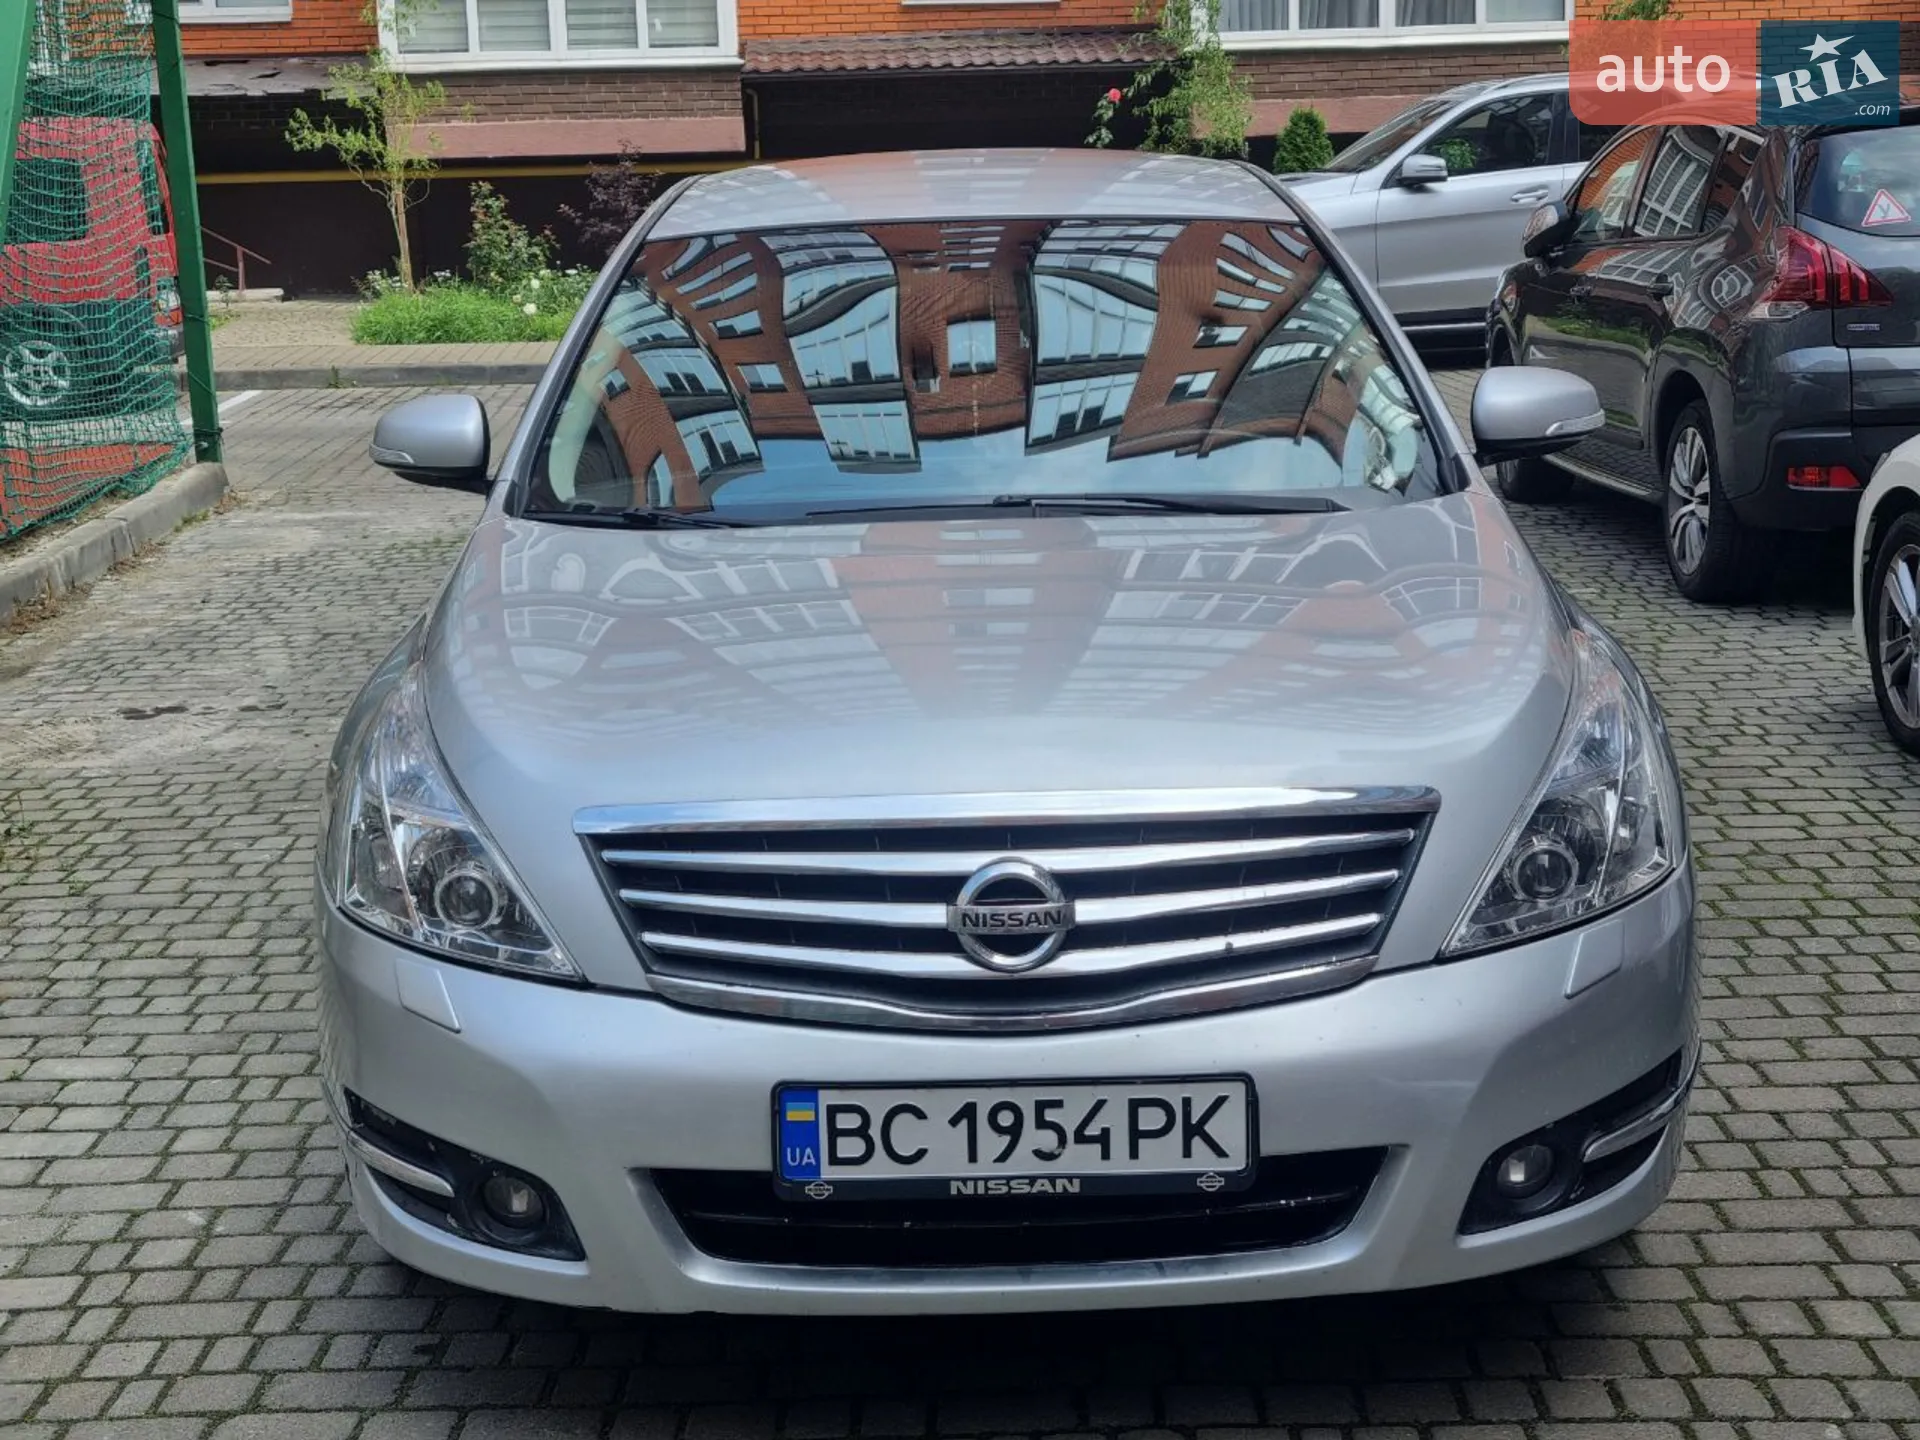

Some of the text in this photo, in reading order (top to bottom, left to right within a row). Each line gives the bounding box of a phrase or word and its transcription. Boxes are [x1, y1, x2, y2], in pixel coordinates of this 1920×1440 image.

[962, 910, 1062, 928] NISSAN
[825, 1094, 1231, 1167] BC 1954 PK
[786, 1147, 816, 1167] UA
[949, 1178, 1081, 1196] NISSAN
